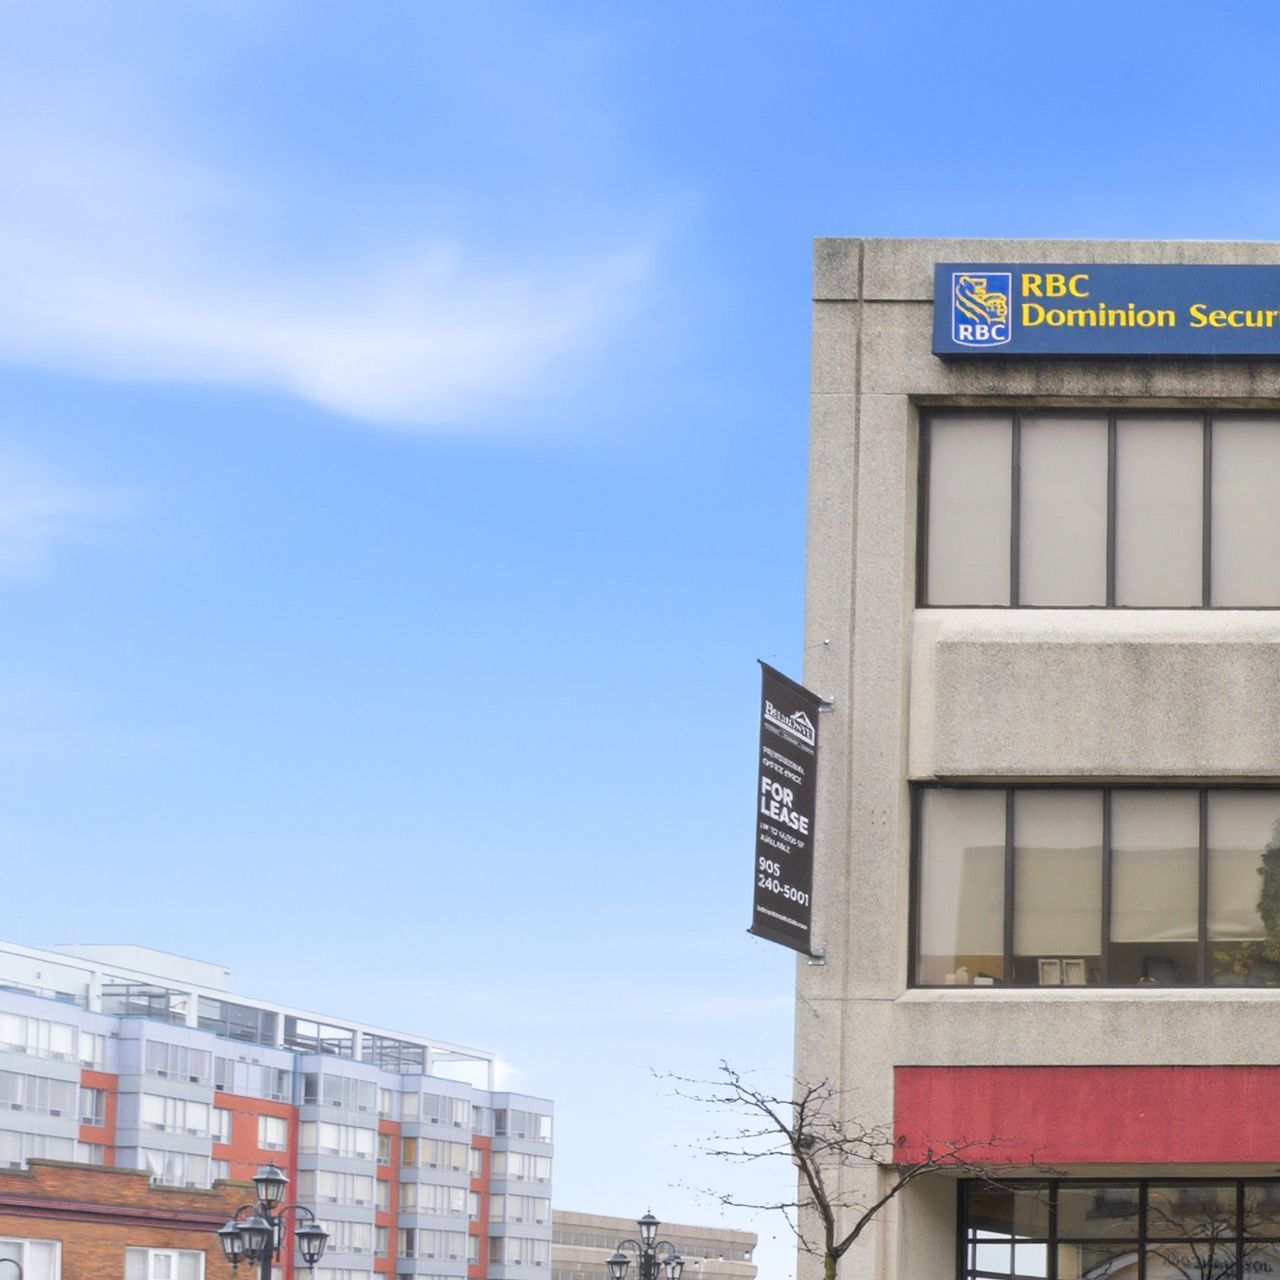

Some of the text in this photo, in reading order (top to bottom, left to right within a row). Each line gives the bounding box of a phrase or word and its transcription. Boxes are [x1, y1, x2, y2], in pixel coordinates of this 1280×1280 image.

[1021, 273, 1089, 297] RBC
[1021, 303, 1176, 328] Dominion
[958, 324, 1006, 341] RBC
[761, 775, 794, 809] FOR
[760, 794, 809, 835] LEASE
[759, 856, 781, 877] 905
[758, 873, 809, 907] 240-5001
